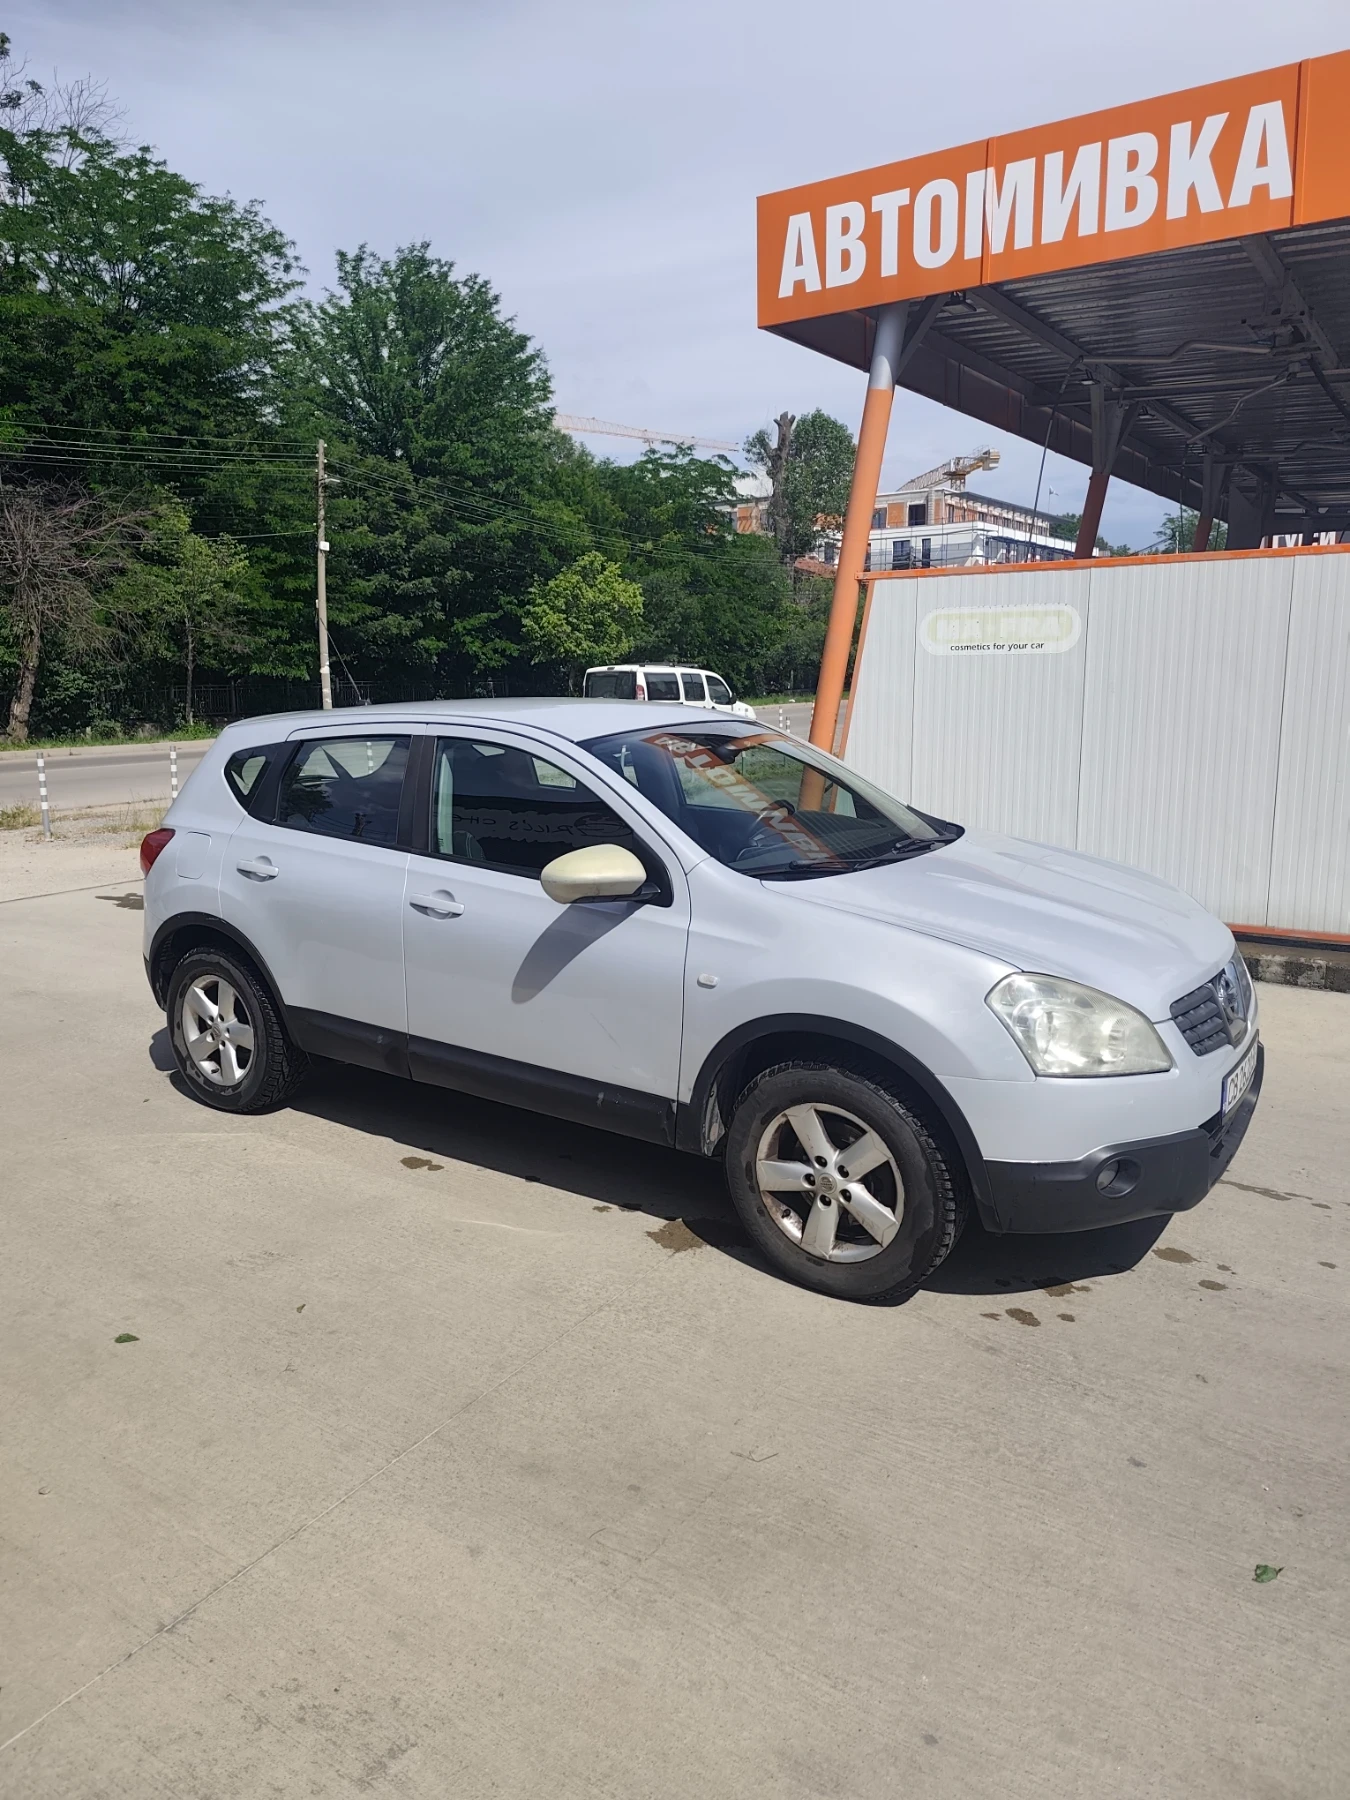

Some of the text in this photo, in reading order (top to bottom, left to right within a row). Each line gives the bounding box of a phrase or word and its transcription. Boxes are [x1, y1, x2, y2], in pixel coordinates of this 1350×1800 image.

[777, 100, 1294, 298] АВТОМИВКА
[950, 641, 1044, 652] cosmetics for your car
